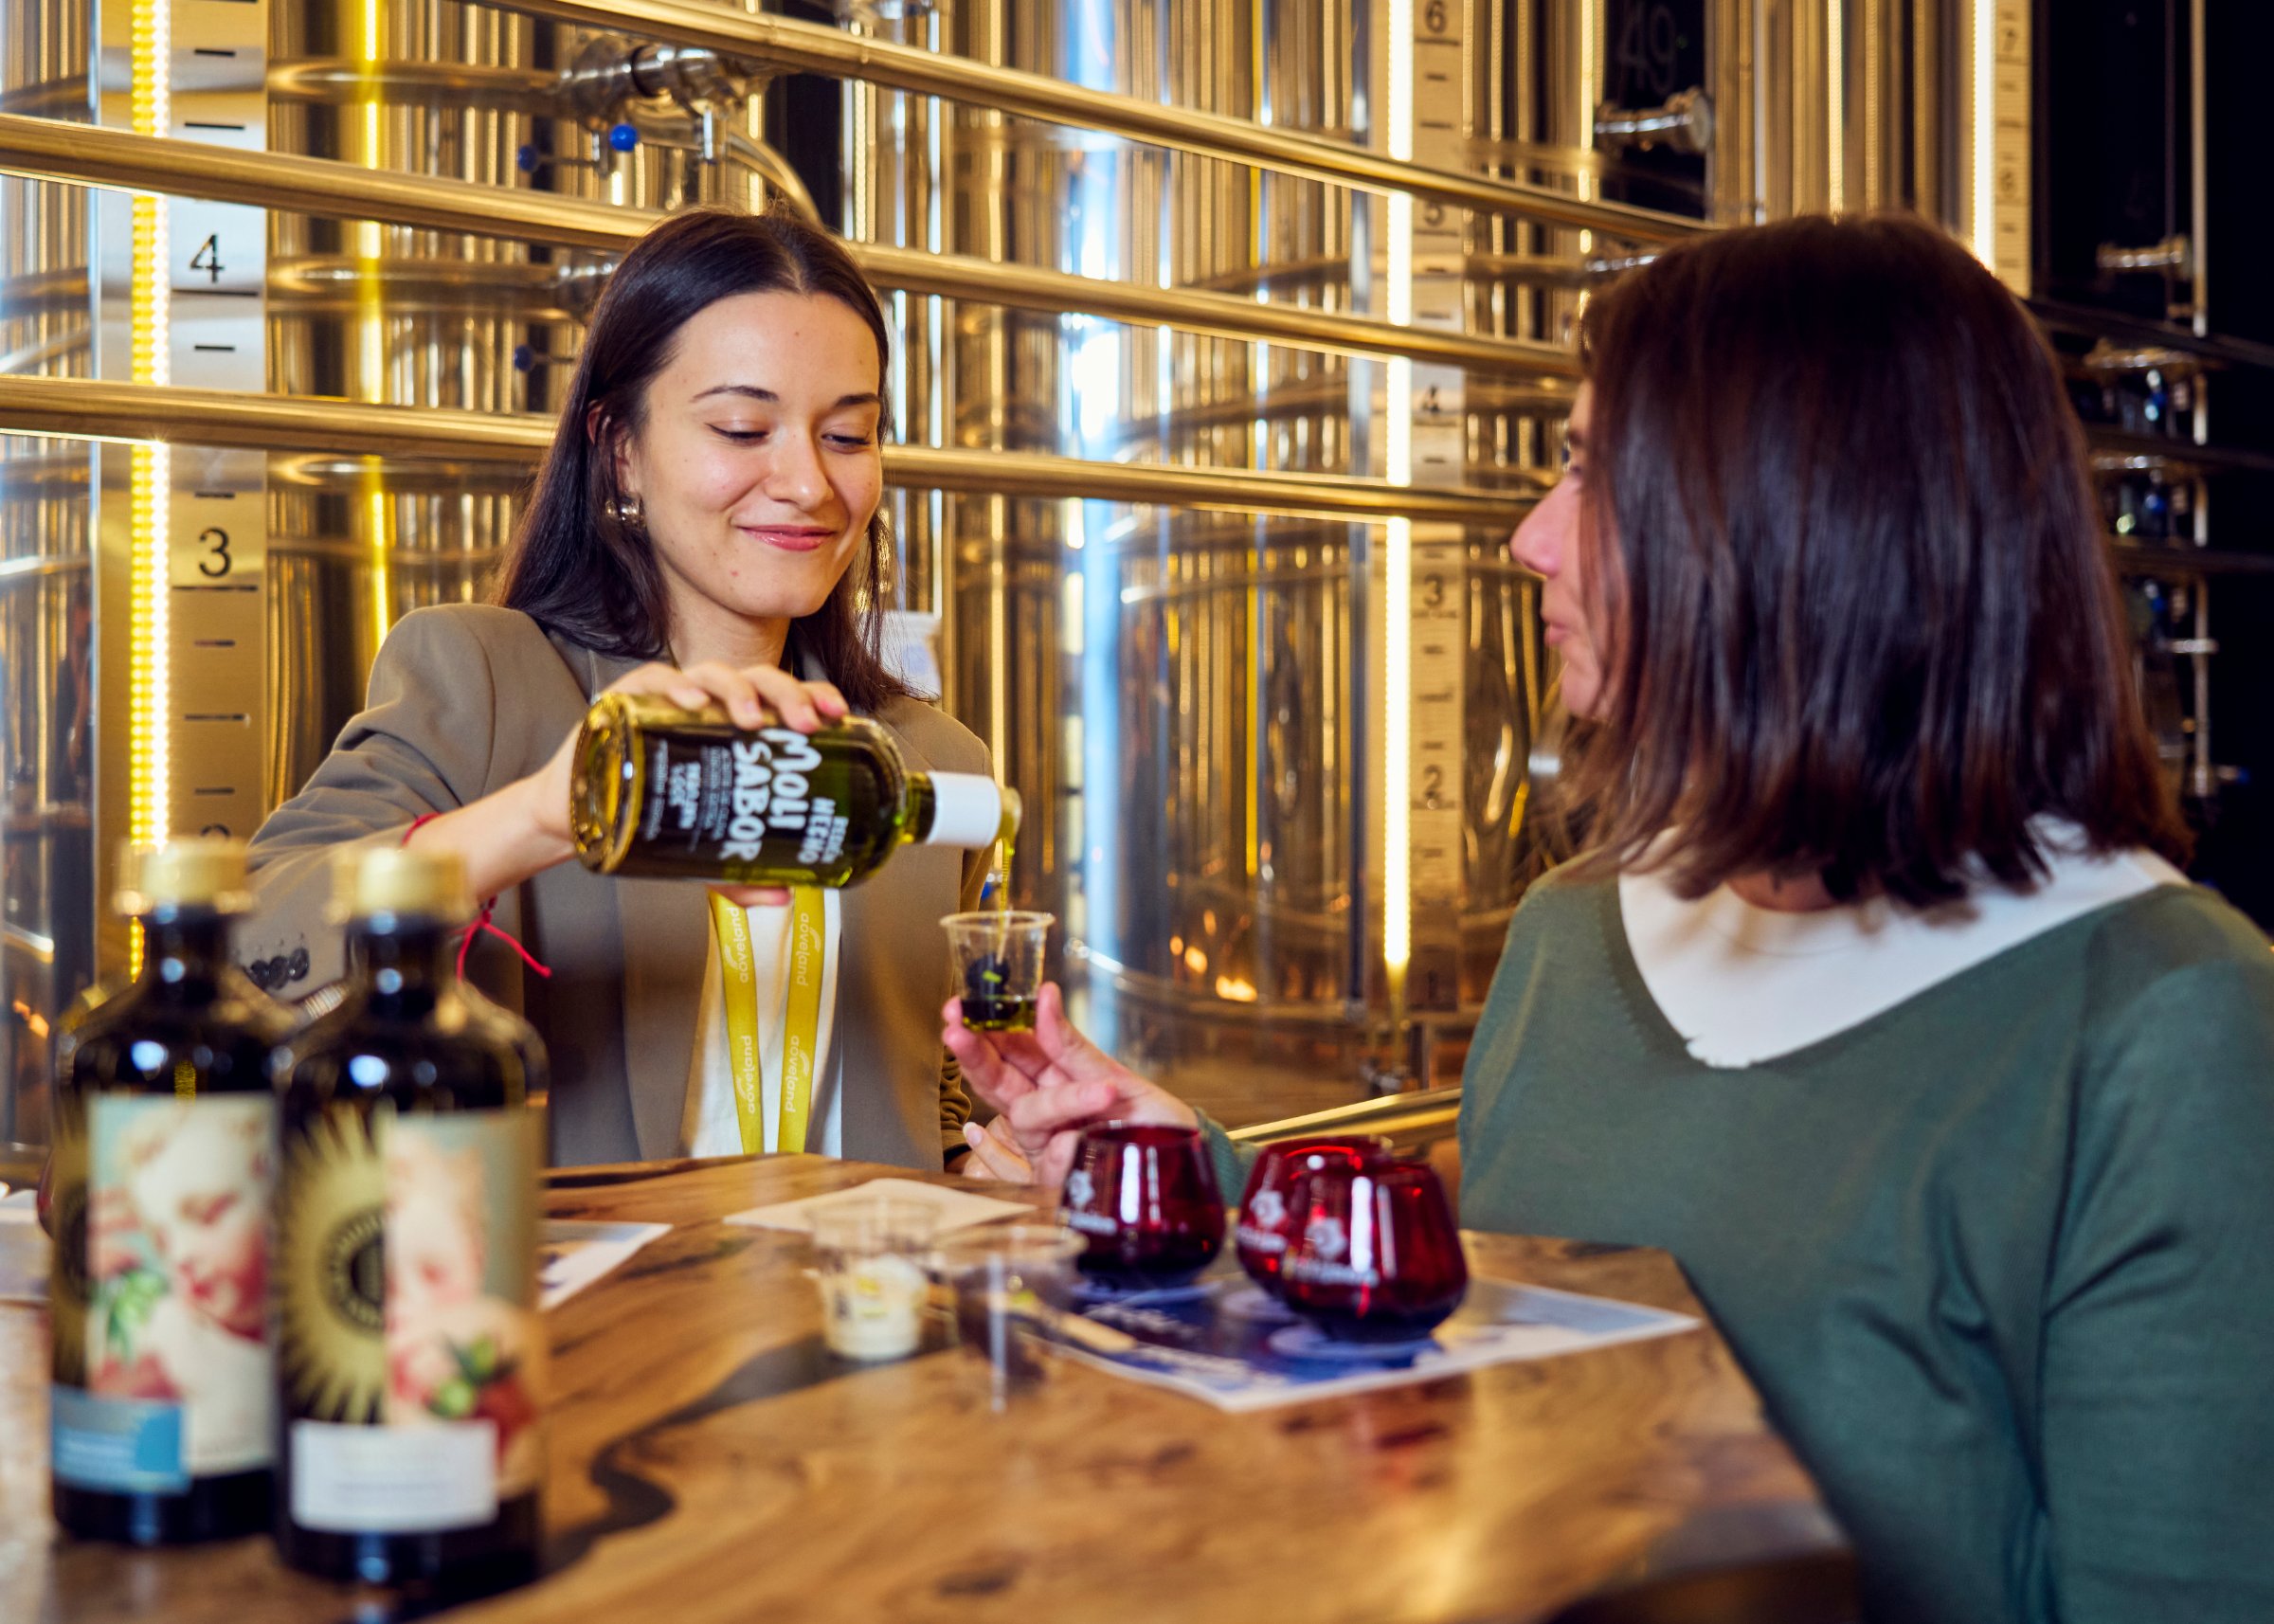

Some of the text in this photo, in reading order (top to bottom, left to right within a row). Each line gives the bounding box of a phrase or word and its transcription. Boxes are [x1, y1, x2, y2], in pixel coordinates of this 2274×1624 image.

[190, 233, 225, 283] 4
[198, 527, 232, 577] 3
[1423, 572, 1444, 607] 3
[718, 740, 772, 861] SABOR
[758, 728, 822, 830] MOLI
[798, 797, 837, 864] HECHO
[727, 906, 749, 983] aoveland
[796, 911, 811, 986] aoveland
[740, 1034, 755, 1115] aoveland
[785, 1034, 800, 1113] aoveland
